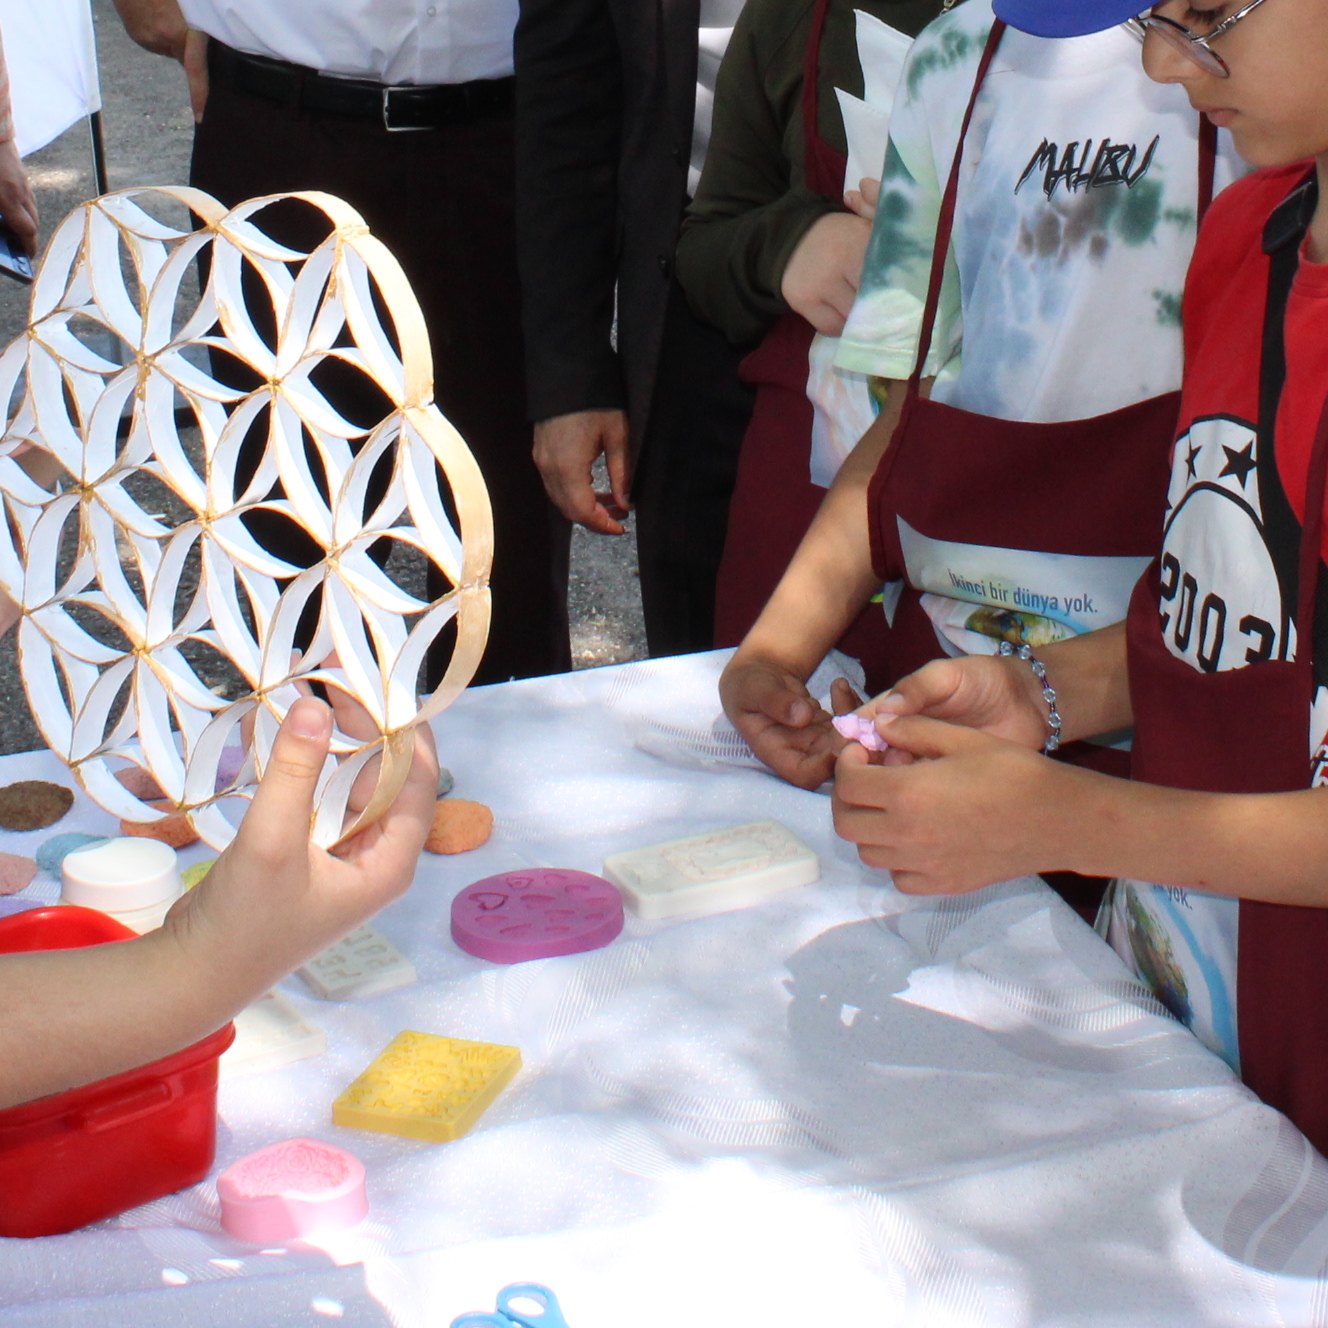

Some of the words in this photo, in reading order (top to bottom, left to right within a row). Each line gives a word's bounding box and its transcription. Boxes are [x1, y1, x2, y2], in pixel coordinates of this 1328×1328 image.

[1014, 133, 1161, 202] MALIBU
[947, 568, 986, 597] İkinci
[989, 581, 1009, 602] bir
[1013, 586, 1058, 614] dünya
[1063, 593, 1098, 617] yok.
